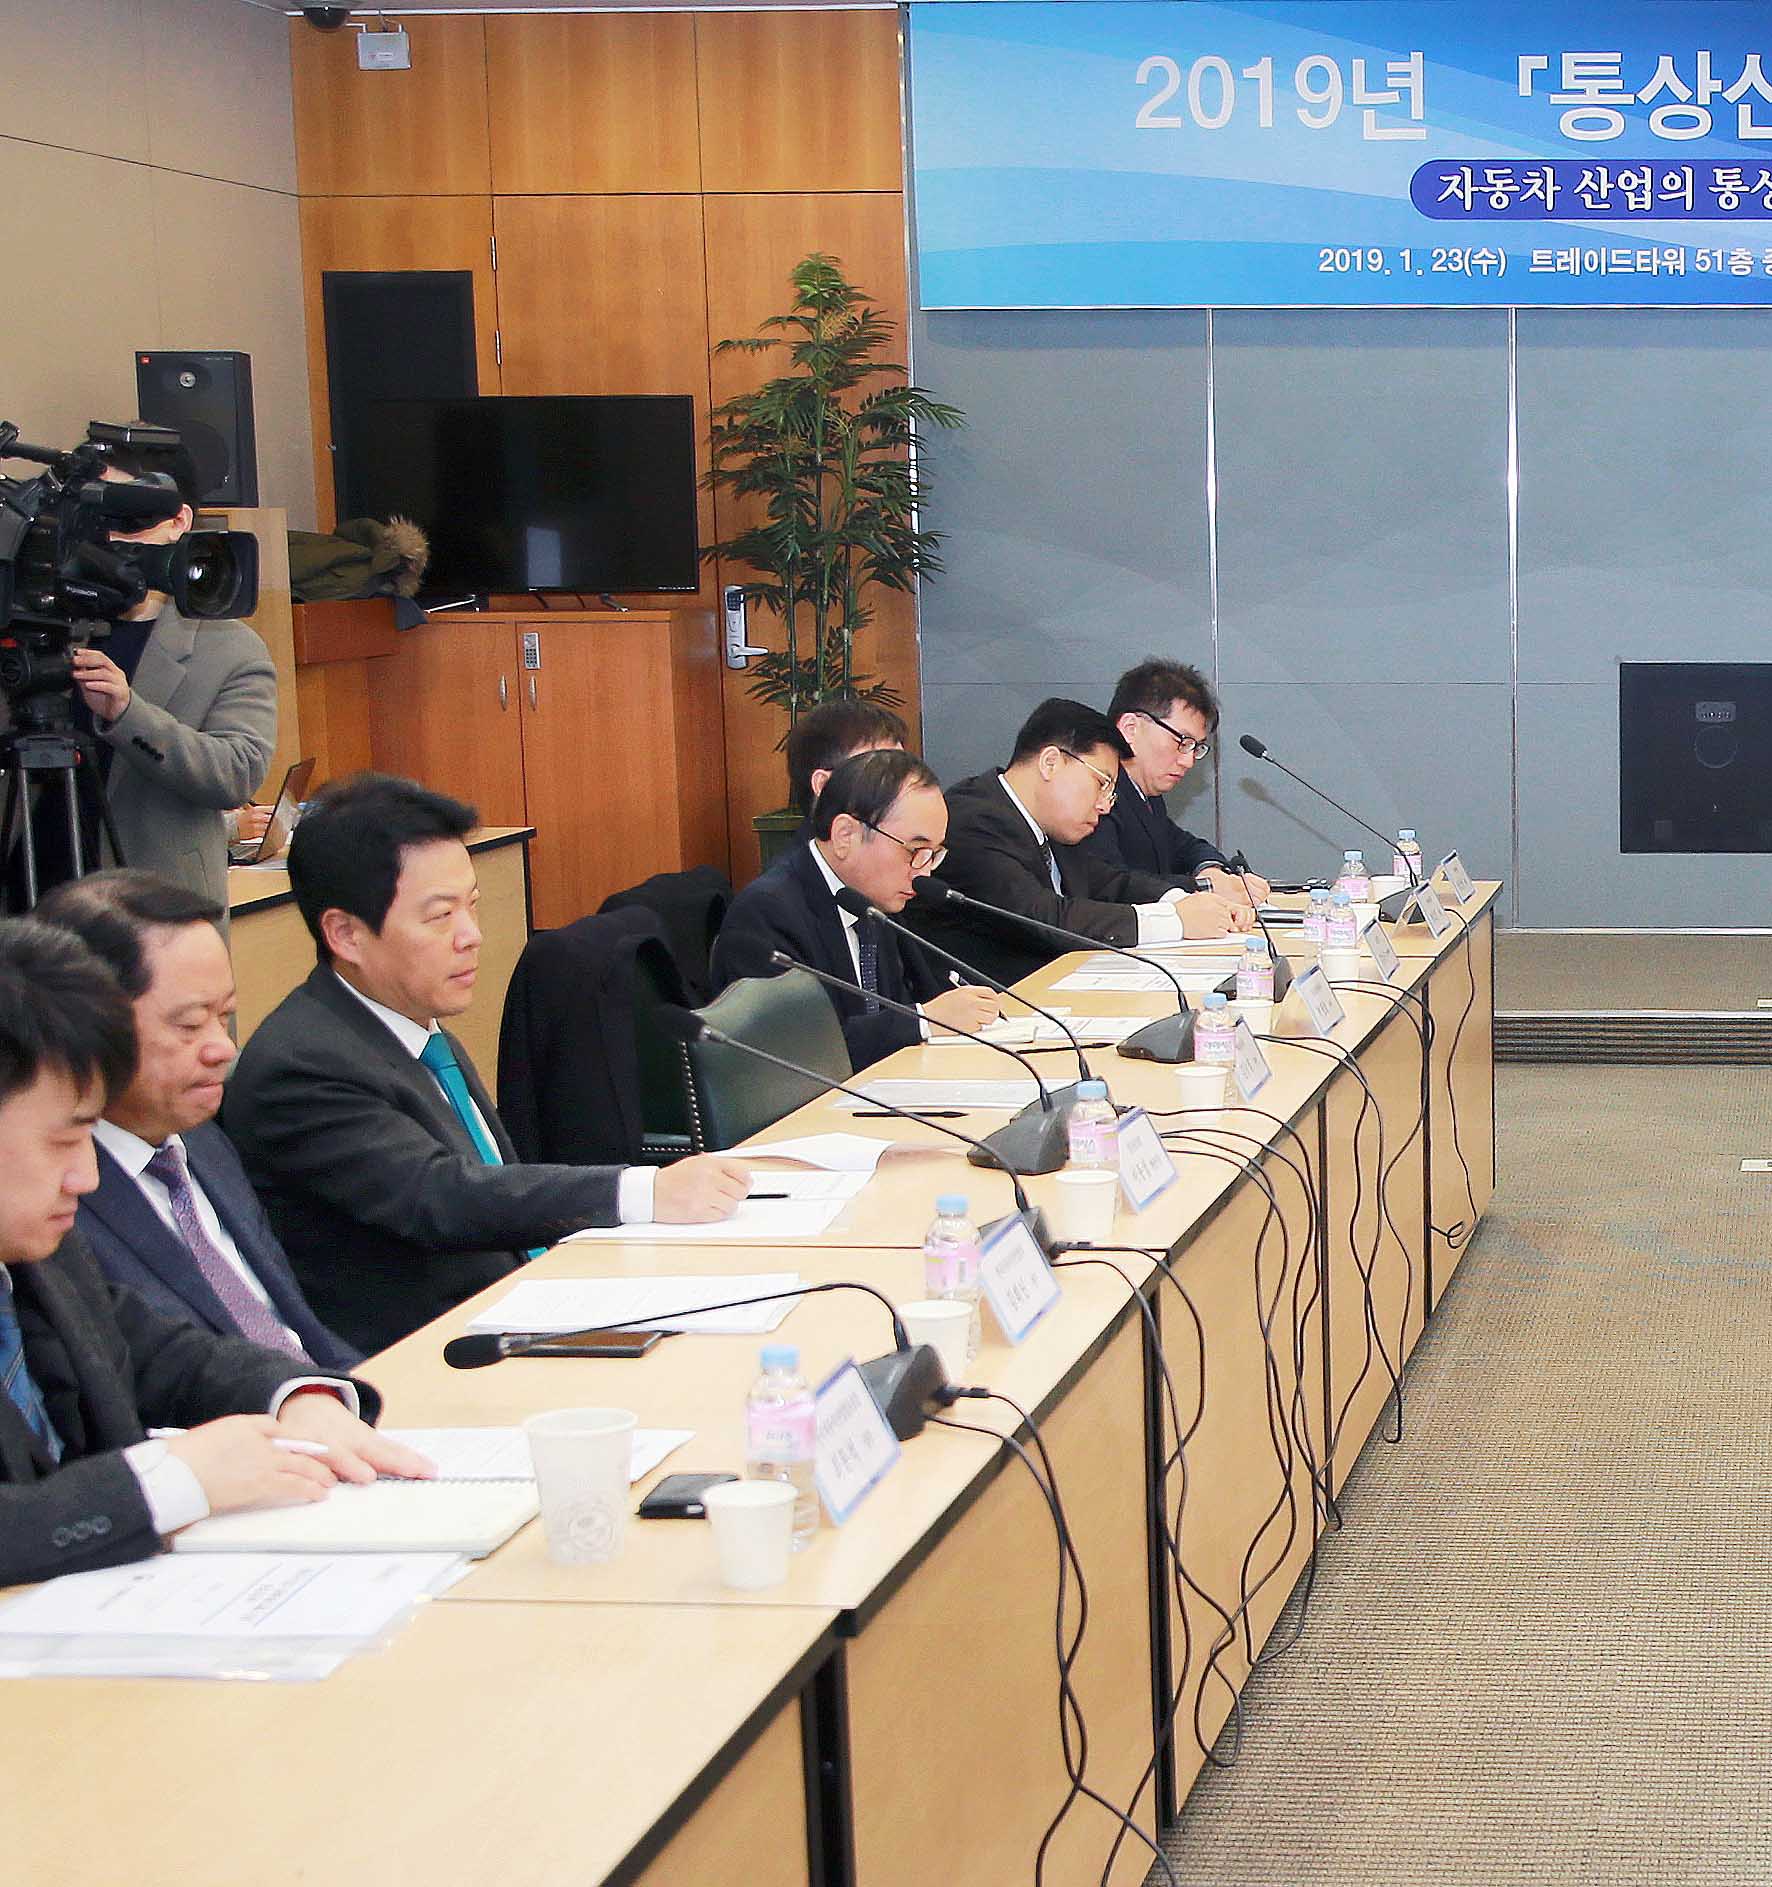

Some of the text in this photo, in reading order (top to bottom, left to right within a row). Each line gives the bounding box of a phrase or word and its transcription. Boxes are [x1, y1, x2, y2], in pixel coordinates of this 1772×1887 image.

[1134, 51, 1430, 143] 2019년
[1437, 165, 1562, 212] 자동차
[1573, 165, 1695, 212] 산업의
[1318, 247, 1392, 276] 2019.
[1399, 248, 1424, 276] 1.
[1431, 246, 1508, 277] 23(수)
[1528, 246, 1686, 276] 트레이드타워
[1694, 247, 1755, 276] 51층
